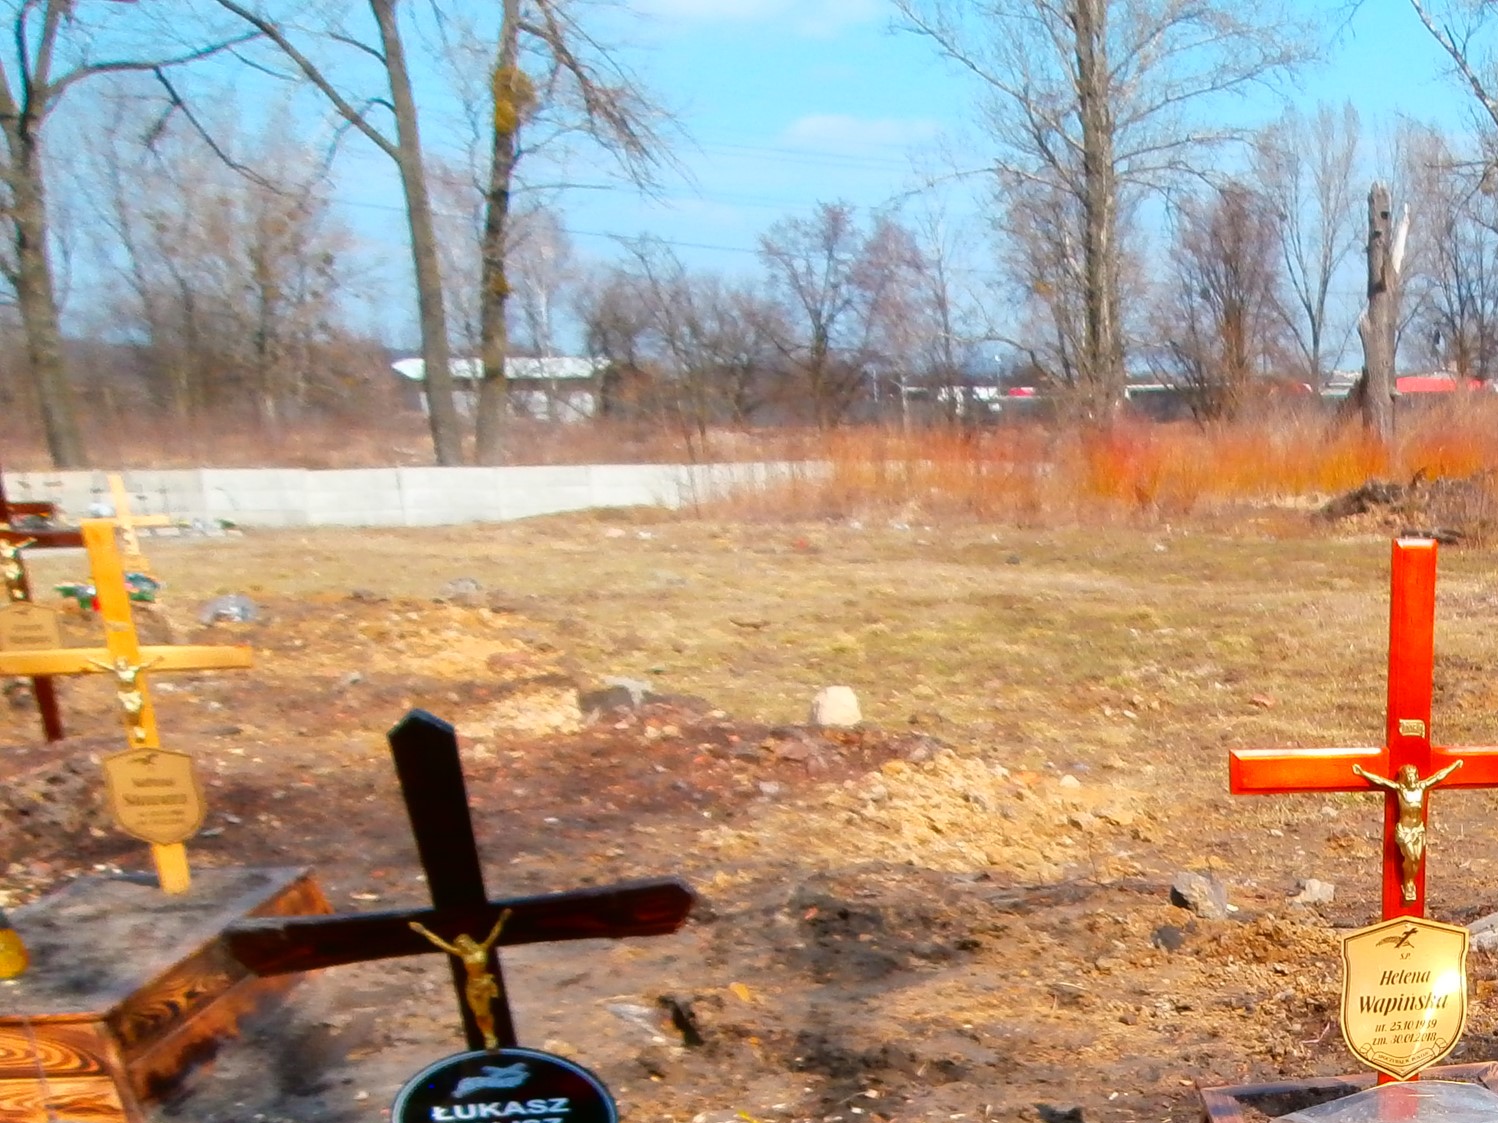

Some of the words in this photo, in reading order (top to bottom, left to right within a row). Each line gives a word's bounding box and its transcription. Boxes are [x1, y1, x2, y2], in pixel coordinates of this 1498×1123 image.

[1379, 969, 1431, 986] Helena
[1375, 1023, 1387, 1033] ur.
[1372, 1037, 1388, 1046] zm.
[430, 1097, 571, 1121] ŁUKASZ
